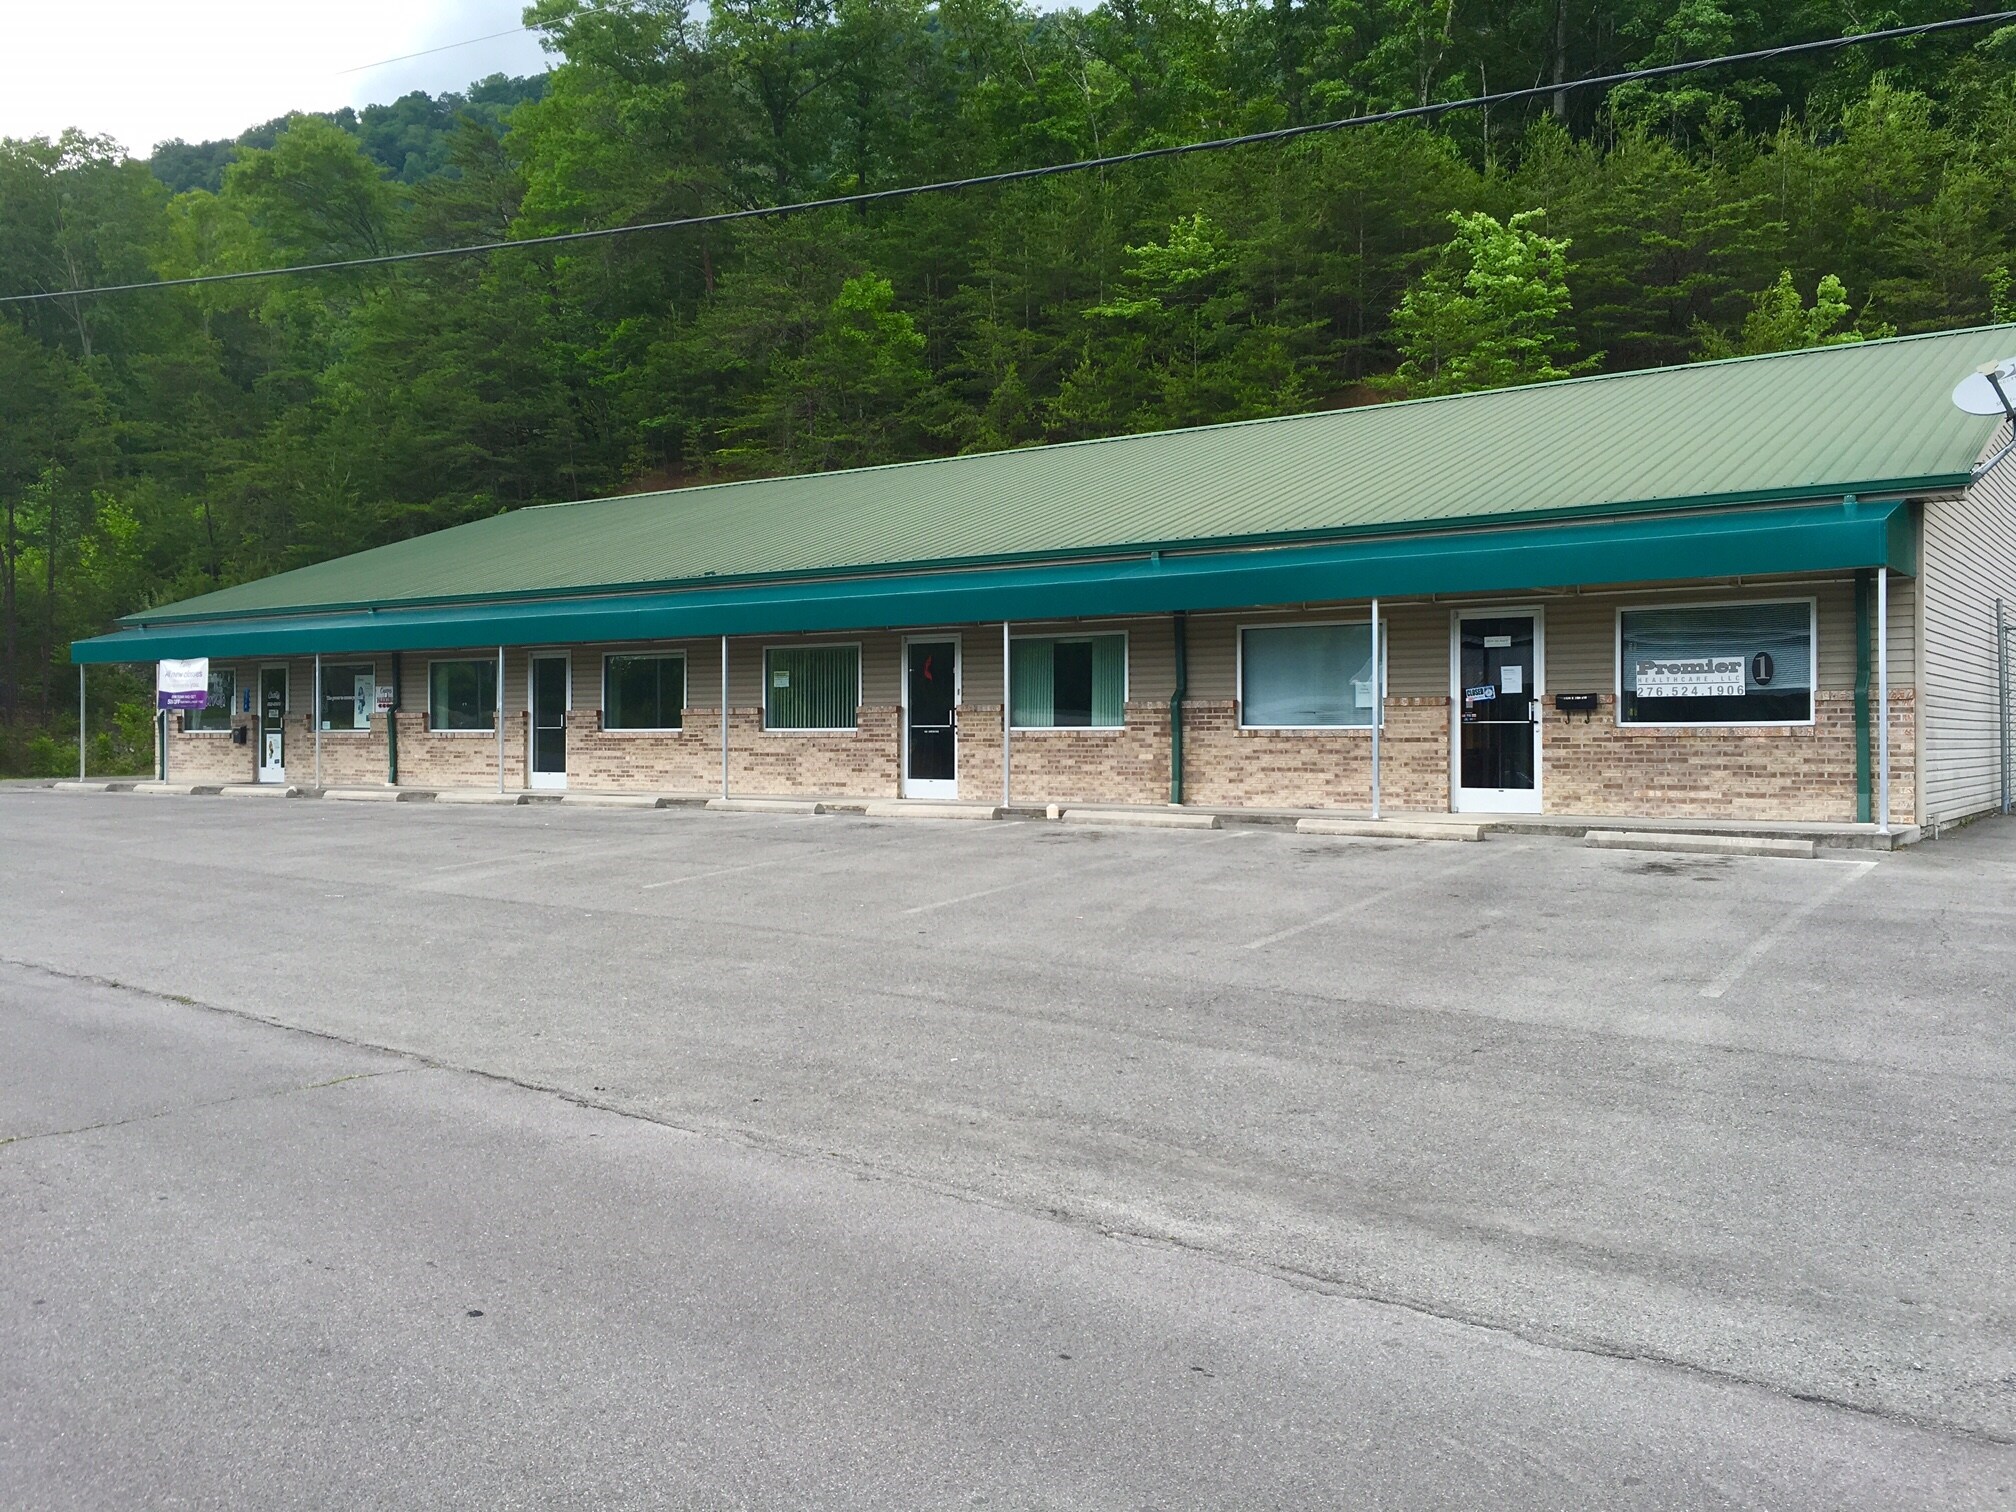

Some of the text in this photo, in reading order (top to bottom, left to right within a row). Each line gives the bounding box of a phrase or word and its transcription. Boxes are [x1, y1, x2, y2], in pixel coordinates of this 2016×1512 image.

[1636, 659, 1742, 676] Premier
[1754, 656, 1770, 680] 1
[1637, 675, 1714, 684] HEALTHCARE,
[1466, 688, 1484, 697] CLOSED
[1637, 685, 1745, 697] 276.524.1906
